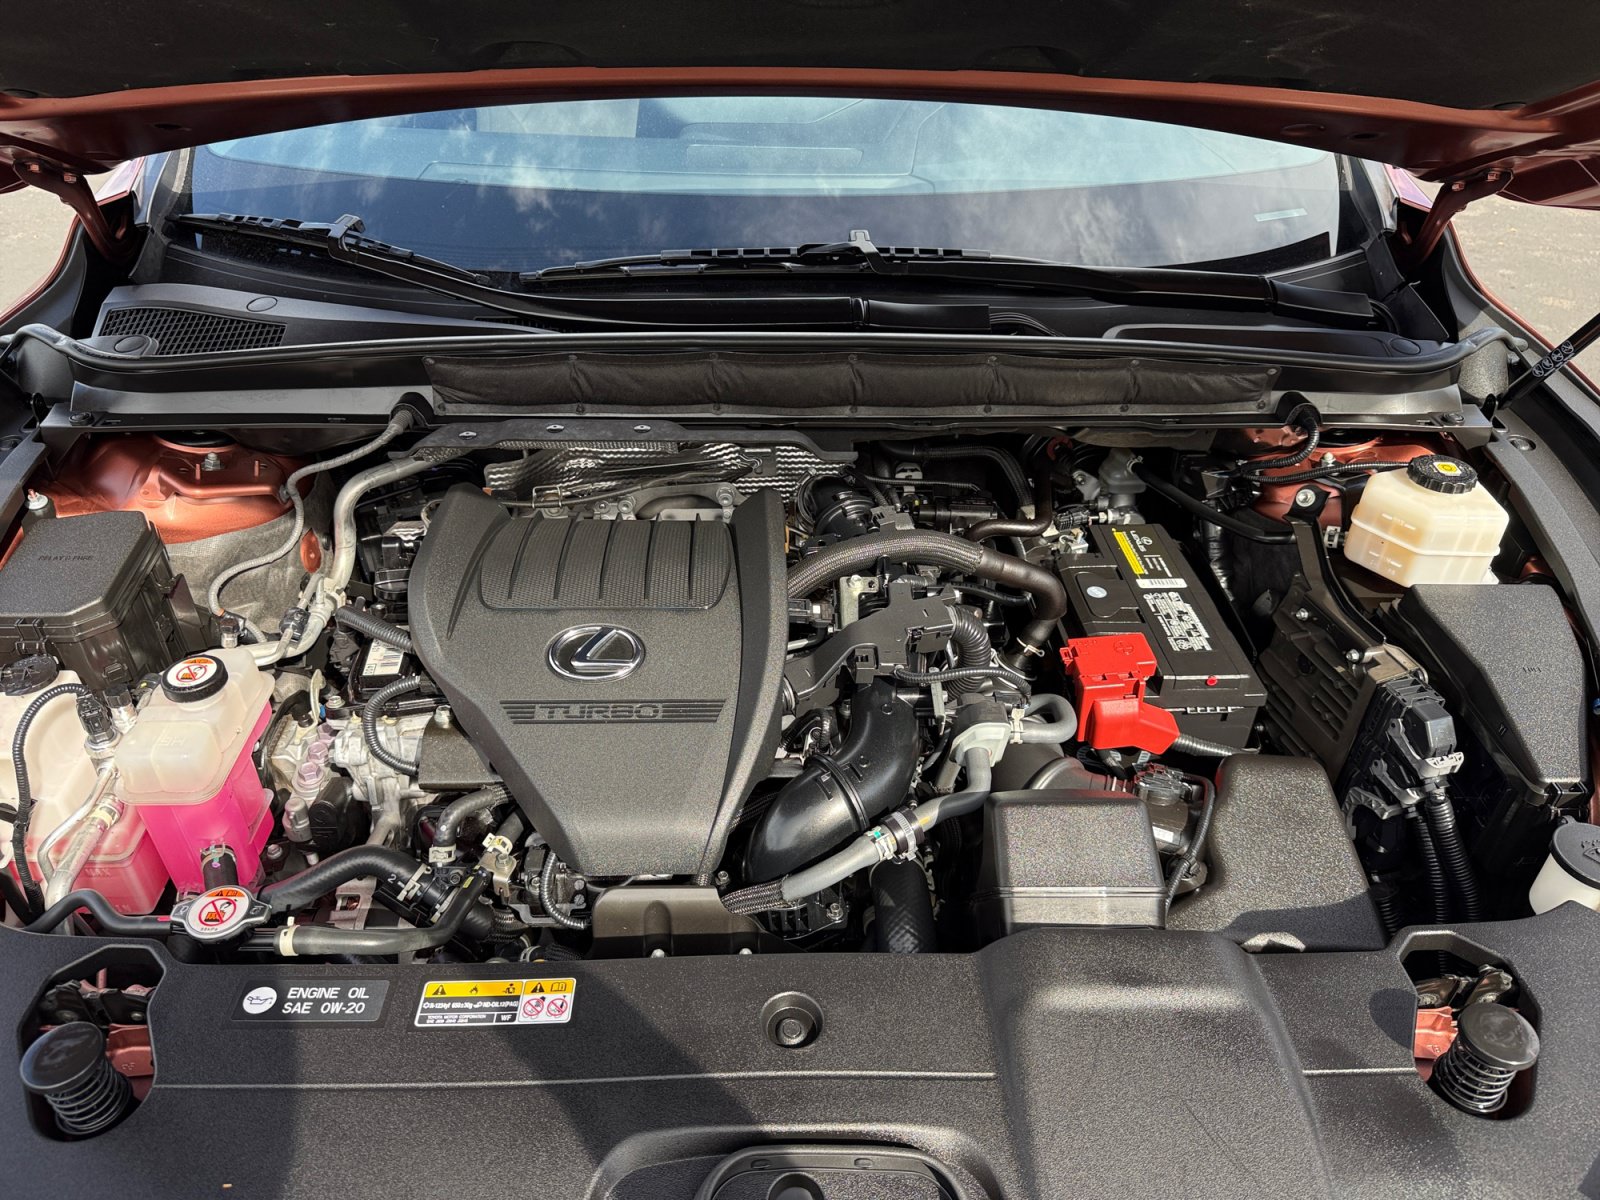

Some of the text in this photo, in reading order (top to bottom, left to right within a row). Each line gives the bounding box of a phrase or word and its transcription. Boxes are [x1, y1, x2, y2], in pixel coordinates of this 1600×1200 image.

[538, 704, 660, 719] TURBO
[387, 873, 397, 884] 2
[287, 987, 370, 999] ENGINE OIL
[281, 1002, 366, 1014] SAE 0W-20
